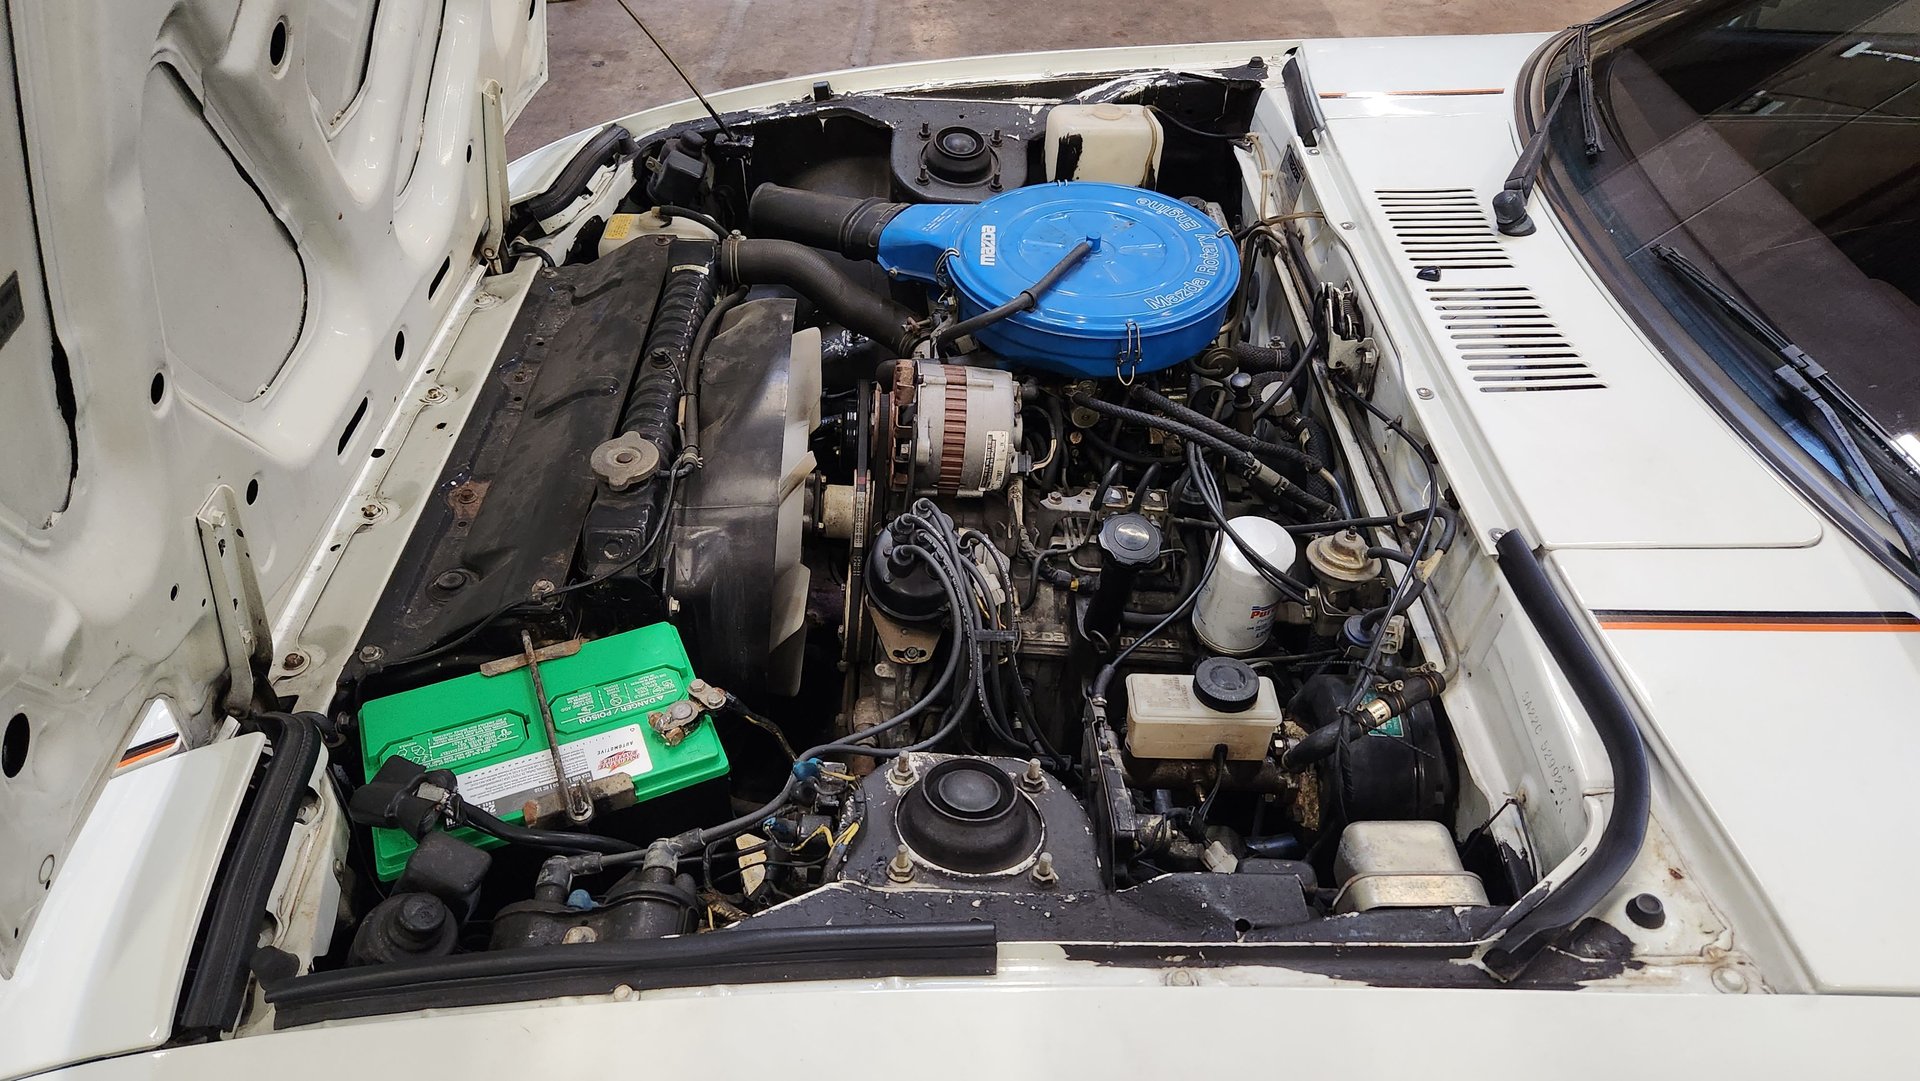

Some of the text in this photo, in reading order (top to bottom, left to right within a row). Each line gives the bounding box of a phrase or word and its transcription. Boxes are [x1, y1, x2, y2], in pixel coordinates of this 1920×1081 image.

[980, 225, 996, 266] mazda
[1136, 196, 1217, 310] Mazda Rotary Engine
[620, 697, 655, 712] DANGER
[578, 710, 612, 724] POISON
[596, 740, 634, 755] AUTOMOTIVE
